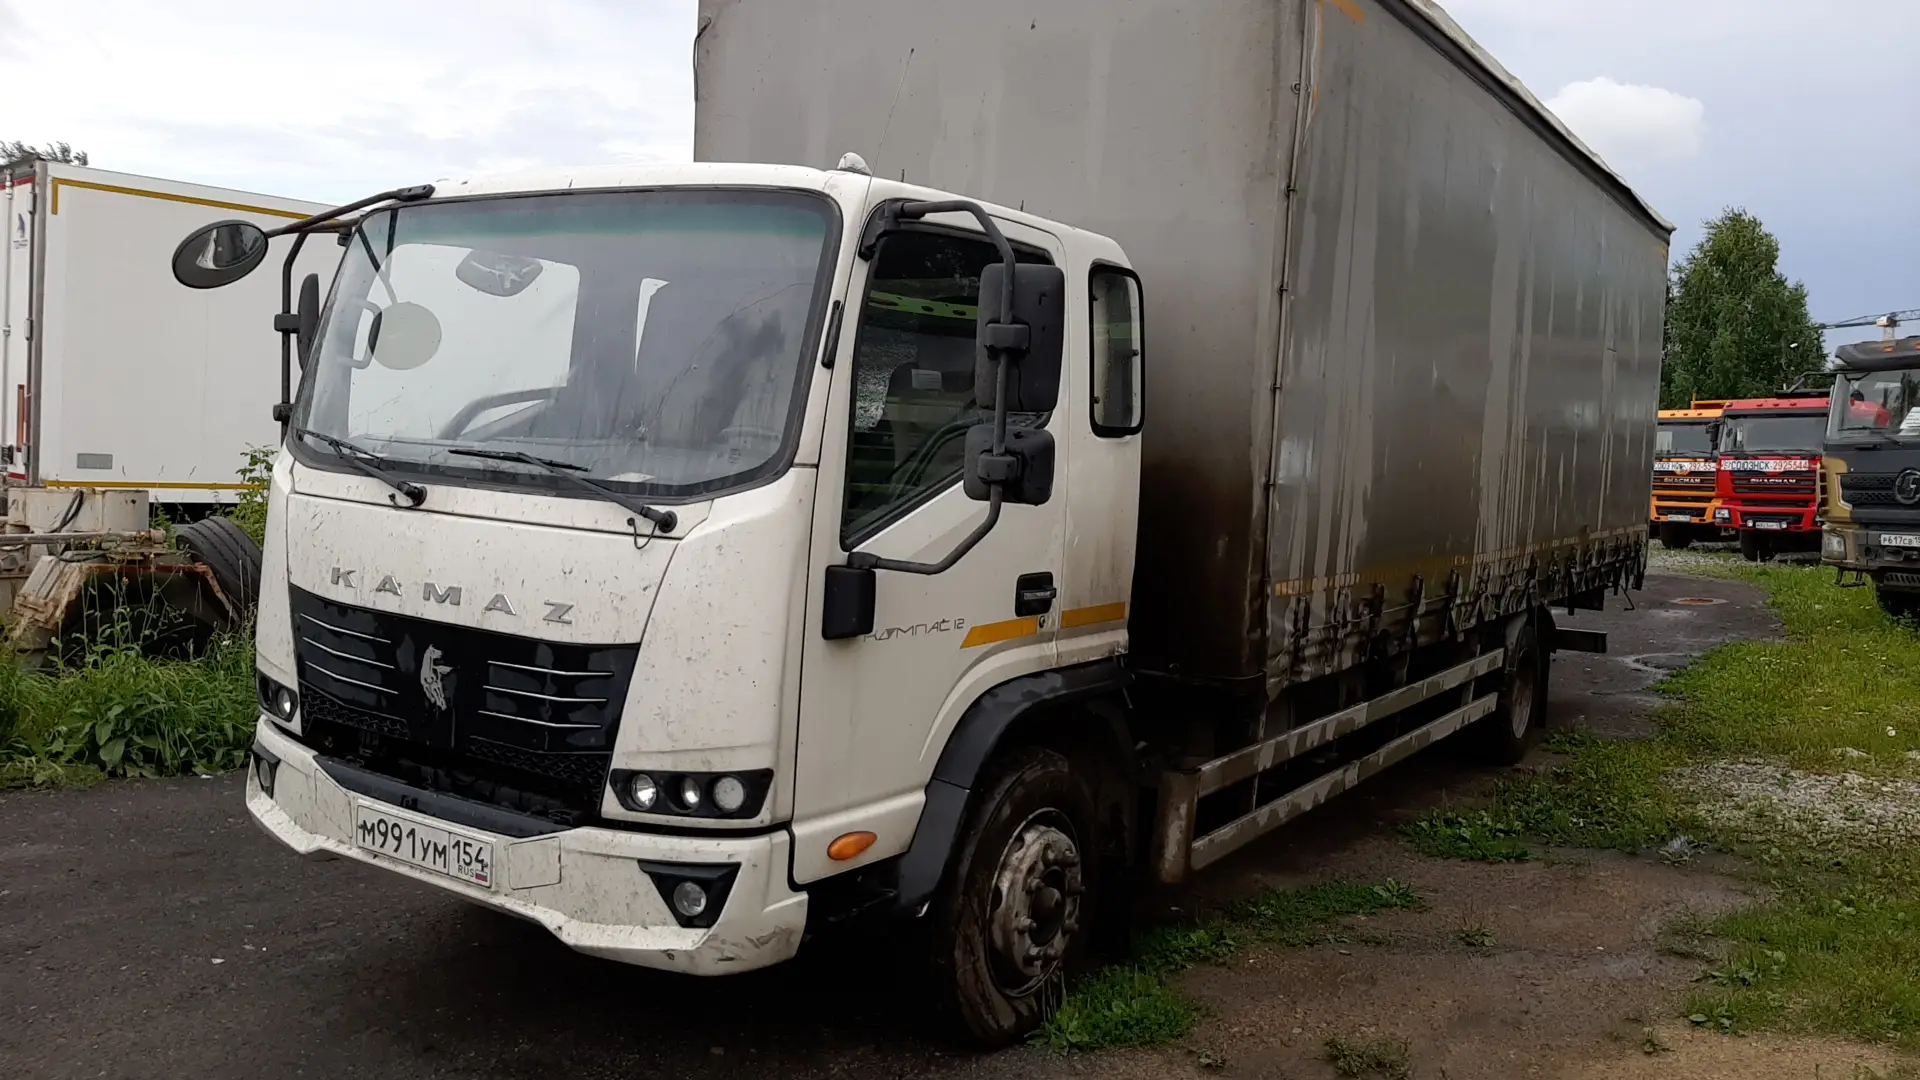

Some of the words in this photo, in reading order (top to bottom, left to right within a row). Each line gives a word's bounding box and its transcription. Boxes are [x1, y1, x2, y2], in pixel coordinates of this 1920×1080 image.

[330, 566, 575, 625] KAMAZ
[451, 839, 488, 872] 154
[457, 864, 475, 878] RUS
